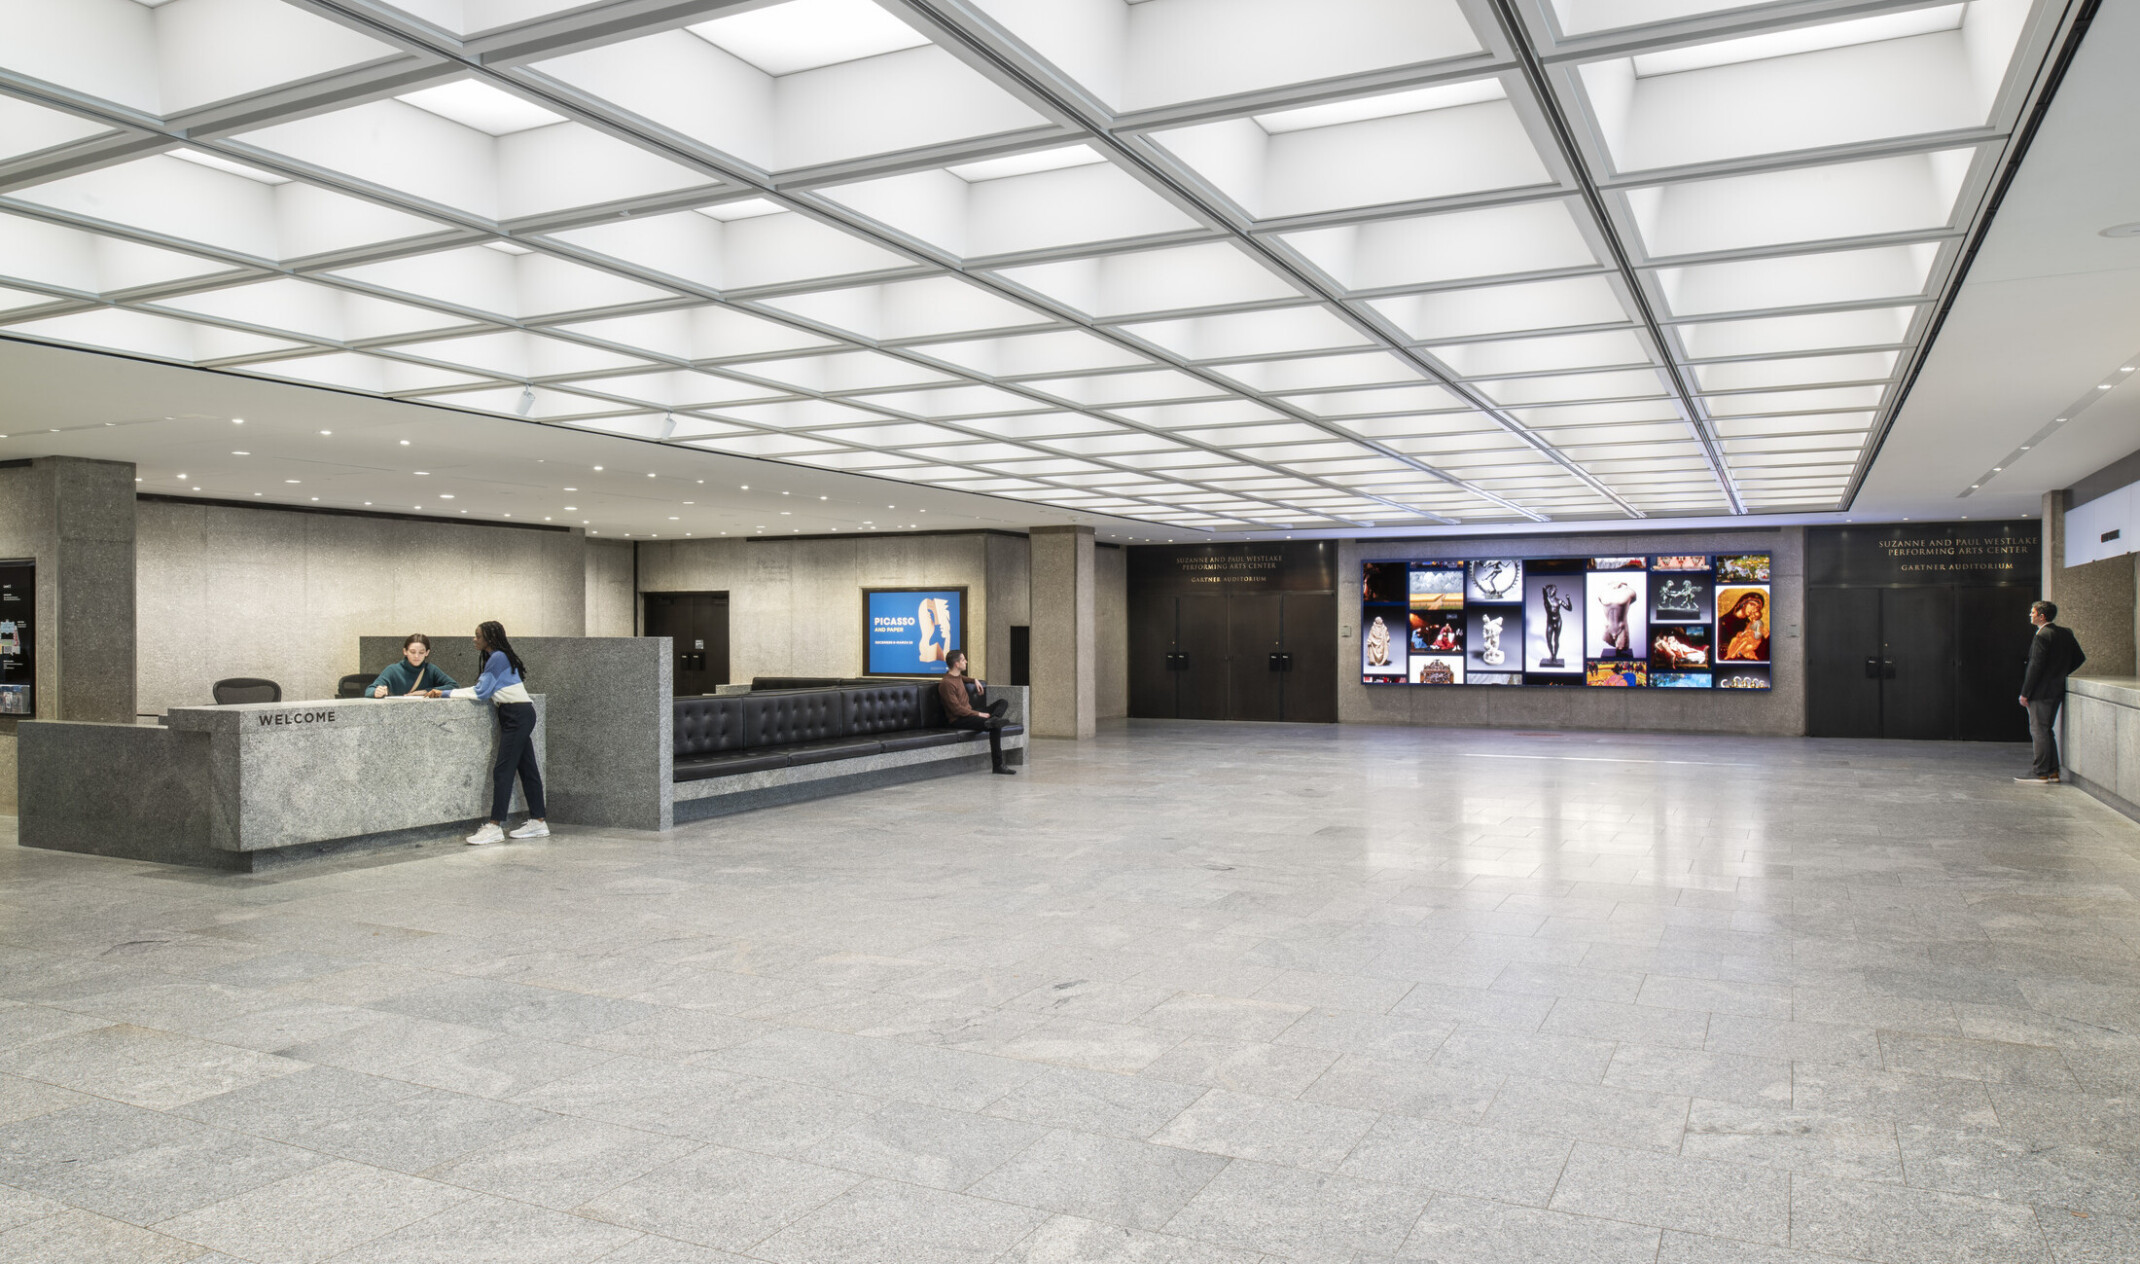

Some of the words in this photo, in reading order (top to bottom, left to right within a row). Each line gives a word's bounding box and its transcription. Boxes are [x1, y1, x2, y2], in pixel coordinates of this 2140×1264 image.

[1878, 539, 1926, 548] SUZANNE
[1929, 539, 1953, 547] AND
[1955, 538, 1981, 546] PAUL
[1983, 537, 2038, 545] WESTLAKE
[1888, 547, 1955, 557] PERFORMING
[1958, 547, 1984, 555] ARTS
[1986, 545, 2029, 554] CENTER
[1176, 556, 1208, 564] SUZANNE
[1901, 563, 1946, 571] GARTNER
[1948, 562, 2014, 570] AUDITORIUM
[874, 617, 915, 626] PICASSO
[259, 711, 336, 726] WELCOME
